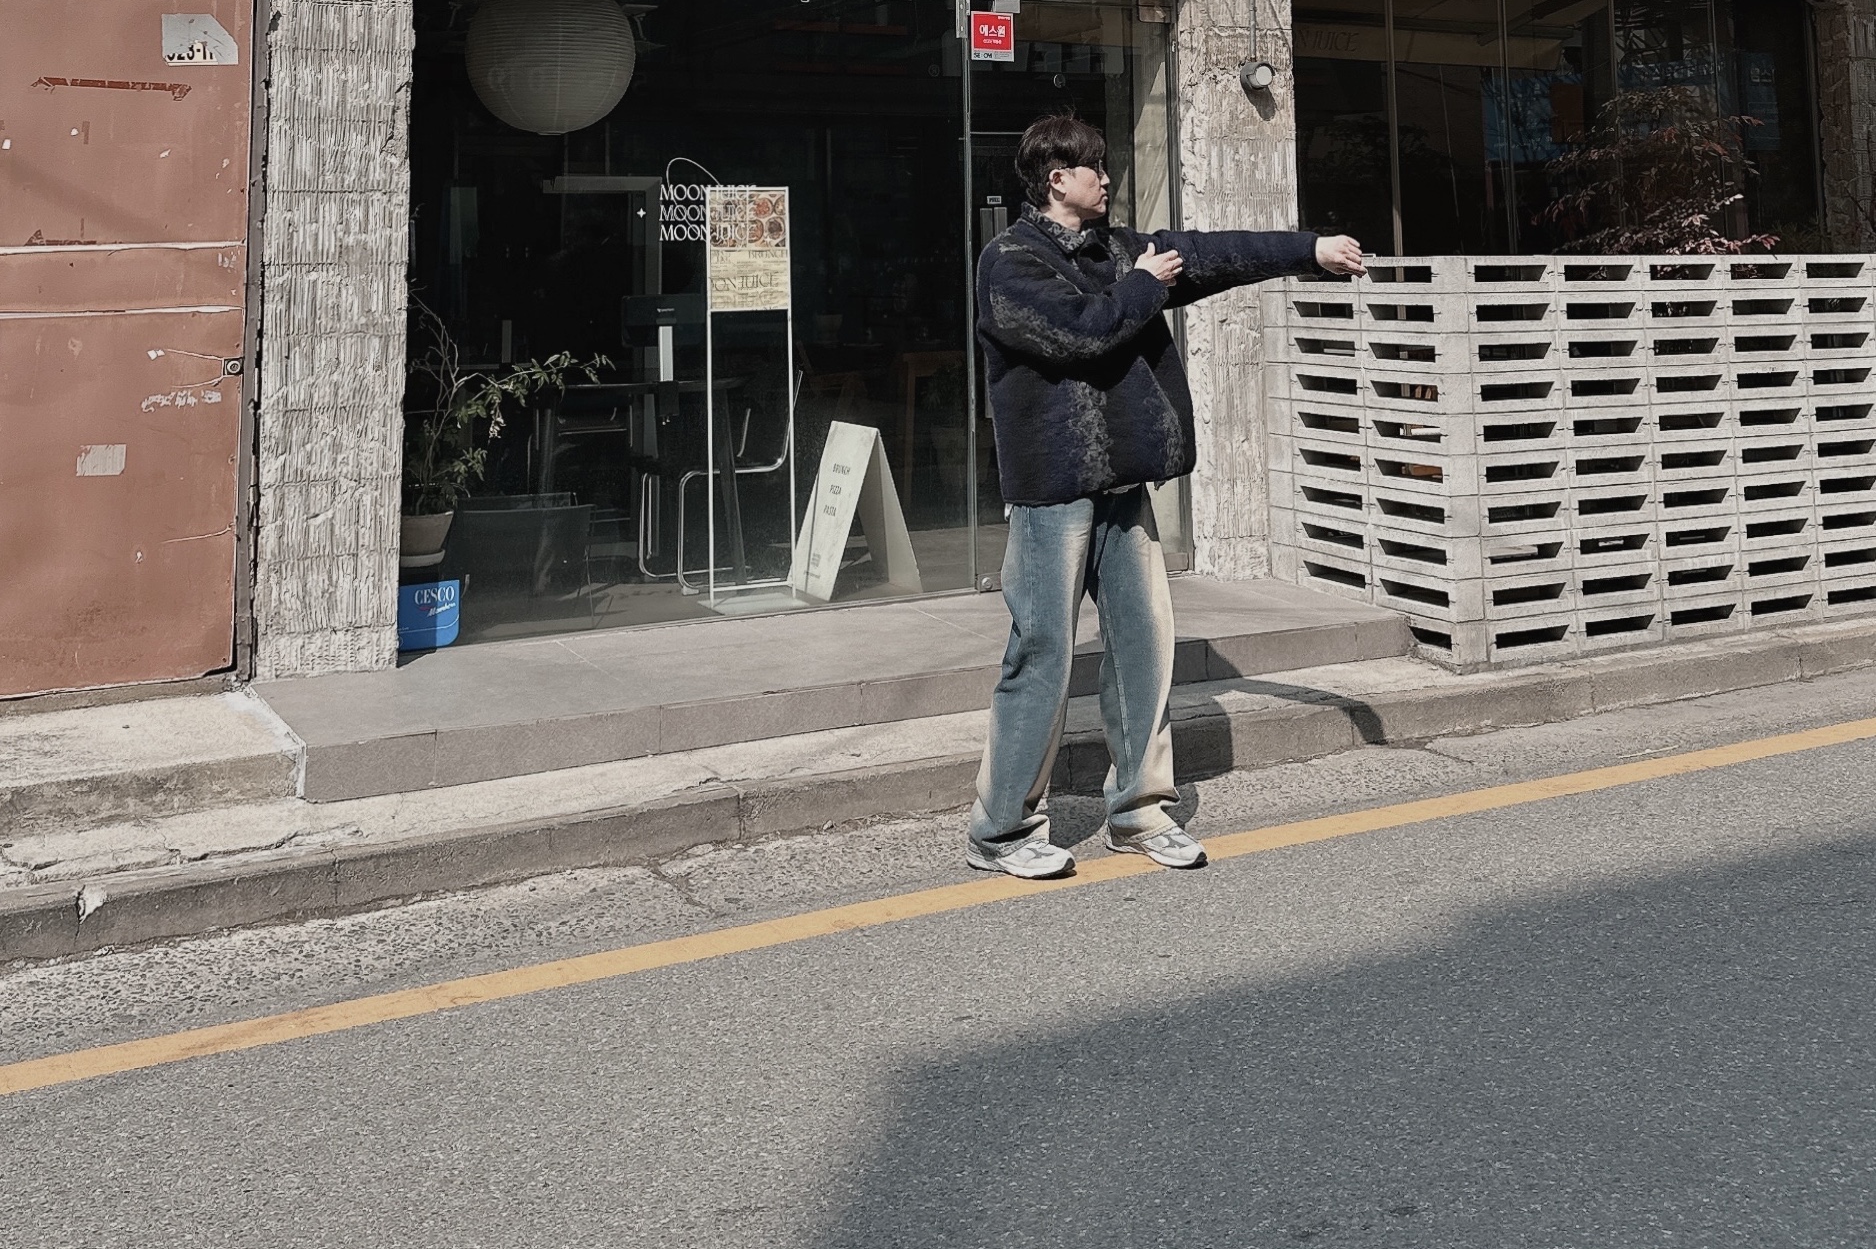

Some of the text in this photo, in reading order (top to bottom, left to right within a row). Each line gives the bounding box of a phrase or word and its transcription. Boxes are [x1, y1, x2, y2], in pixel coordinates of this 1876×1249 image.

[979, 24, 1006, 38] 에스원
[660, 184, 709, 201] MOON
[659, 204, 709, 222] MOON
[660, 224, 709, 241] MOON
[833, 463, 851, 475] BRUNCH
[829, 484, 842, 495] PIZZA
[823, 504, 837, 517] PASTA
[415, 586, 455, 605] CESCO
